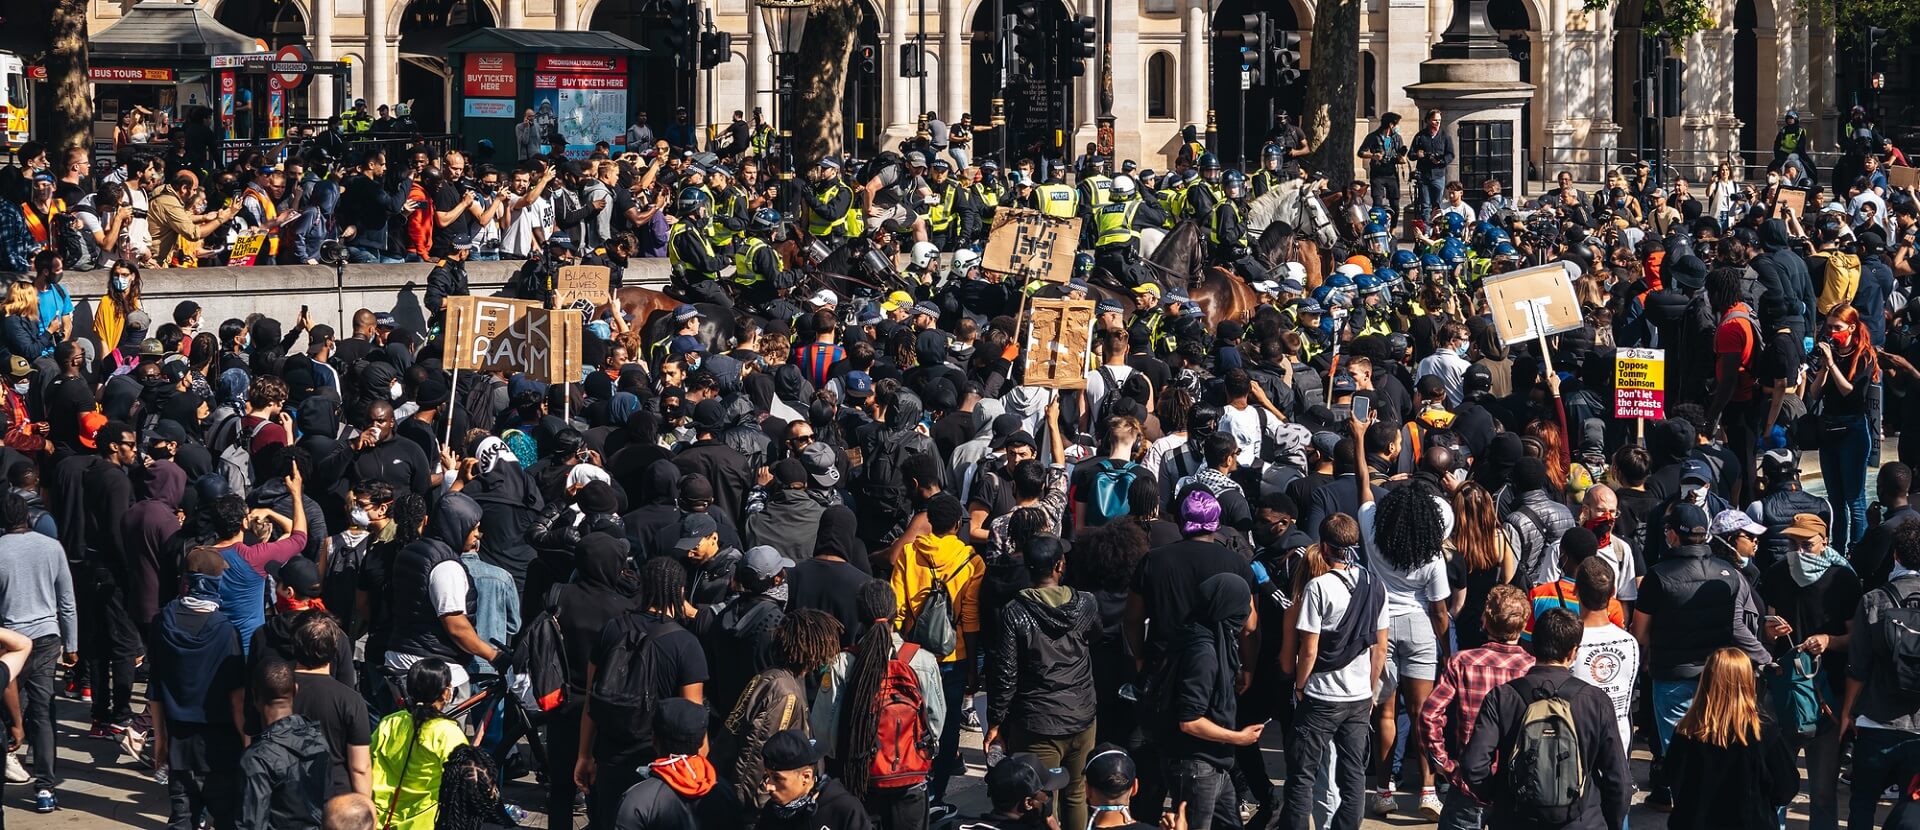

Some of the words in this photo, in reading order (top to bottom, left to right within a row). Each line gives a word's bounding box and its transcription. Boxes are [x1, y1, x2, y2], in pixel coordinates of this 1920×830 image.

[95, 68, 112, 78] BUS
[113, 69, 143, 79] TOURS
[484, 74, 513, 82] TICKETS
[562, 78, 577, 86] BUY
[577, 78, 605, 87] TICKETS
[606, 79, 624, 87] HERE
[1051, 192, 1069, 200] POLICE
[1104, 204, 1124, 212] POLICE
[565, 270, 602, 281] BLACK
[569, 281, 598, 289] LIVES
[566, 290, 606, 299] MATTER
[1618, 361, 1648, 370] Oppose
[1618, 369, 1647, 379] Tommy
[1618, 378, 1655, 388] Robinson
[1618, 389, 1641, 398] Don't
[1642, 390, 1653, 399] let
[1618, 398, 1632, 407] the
[1634, 399, 1662, 408] racists
[1617, 407, 1643, 416] divide
[1644, 409, 1654, 417] us
[1584, 649, 1600, 666] JOHN
[1601, 647, 1627, 661] MAYER
